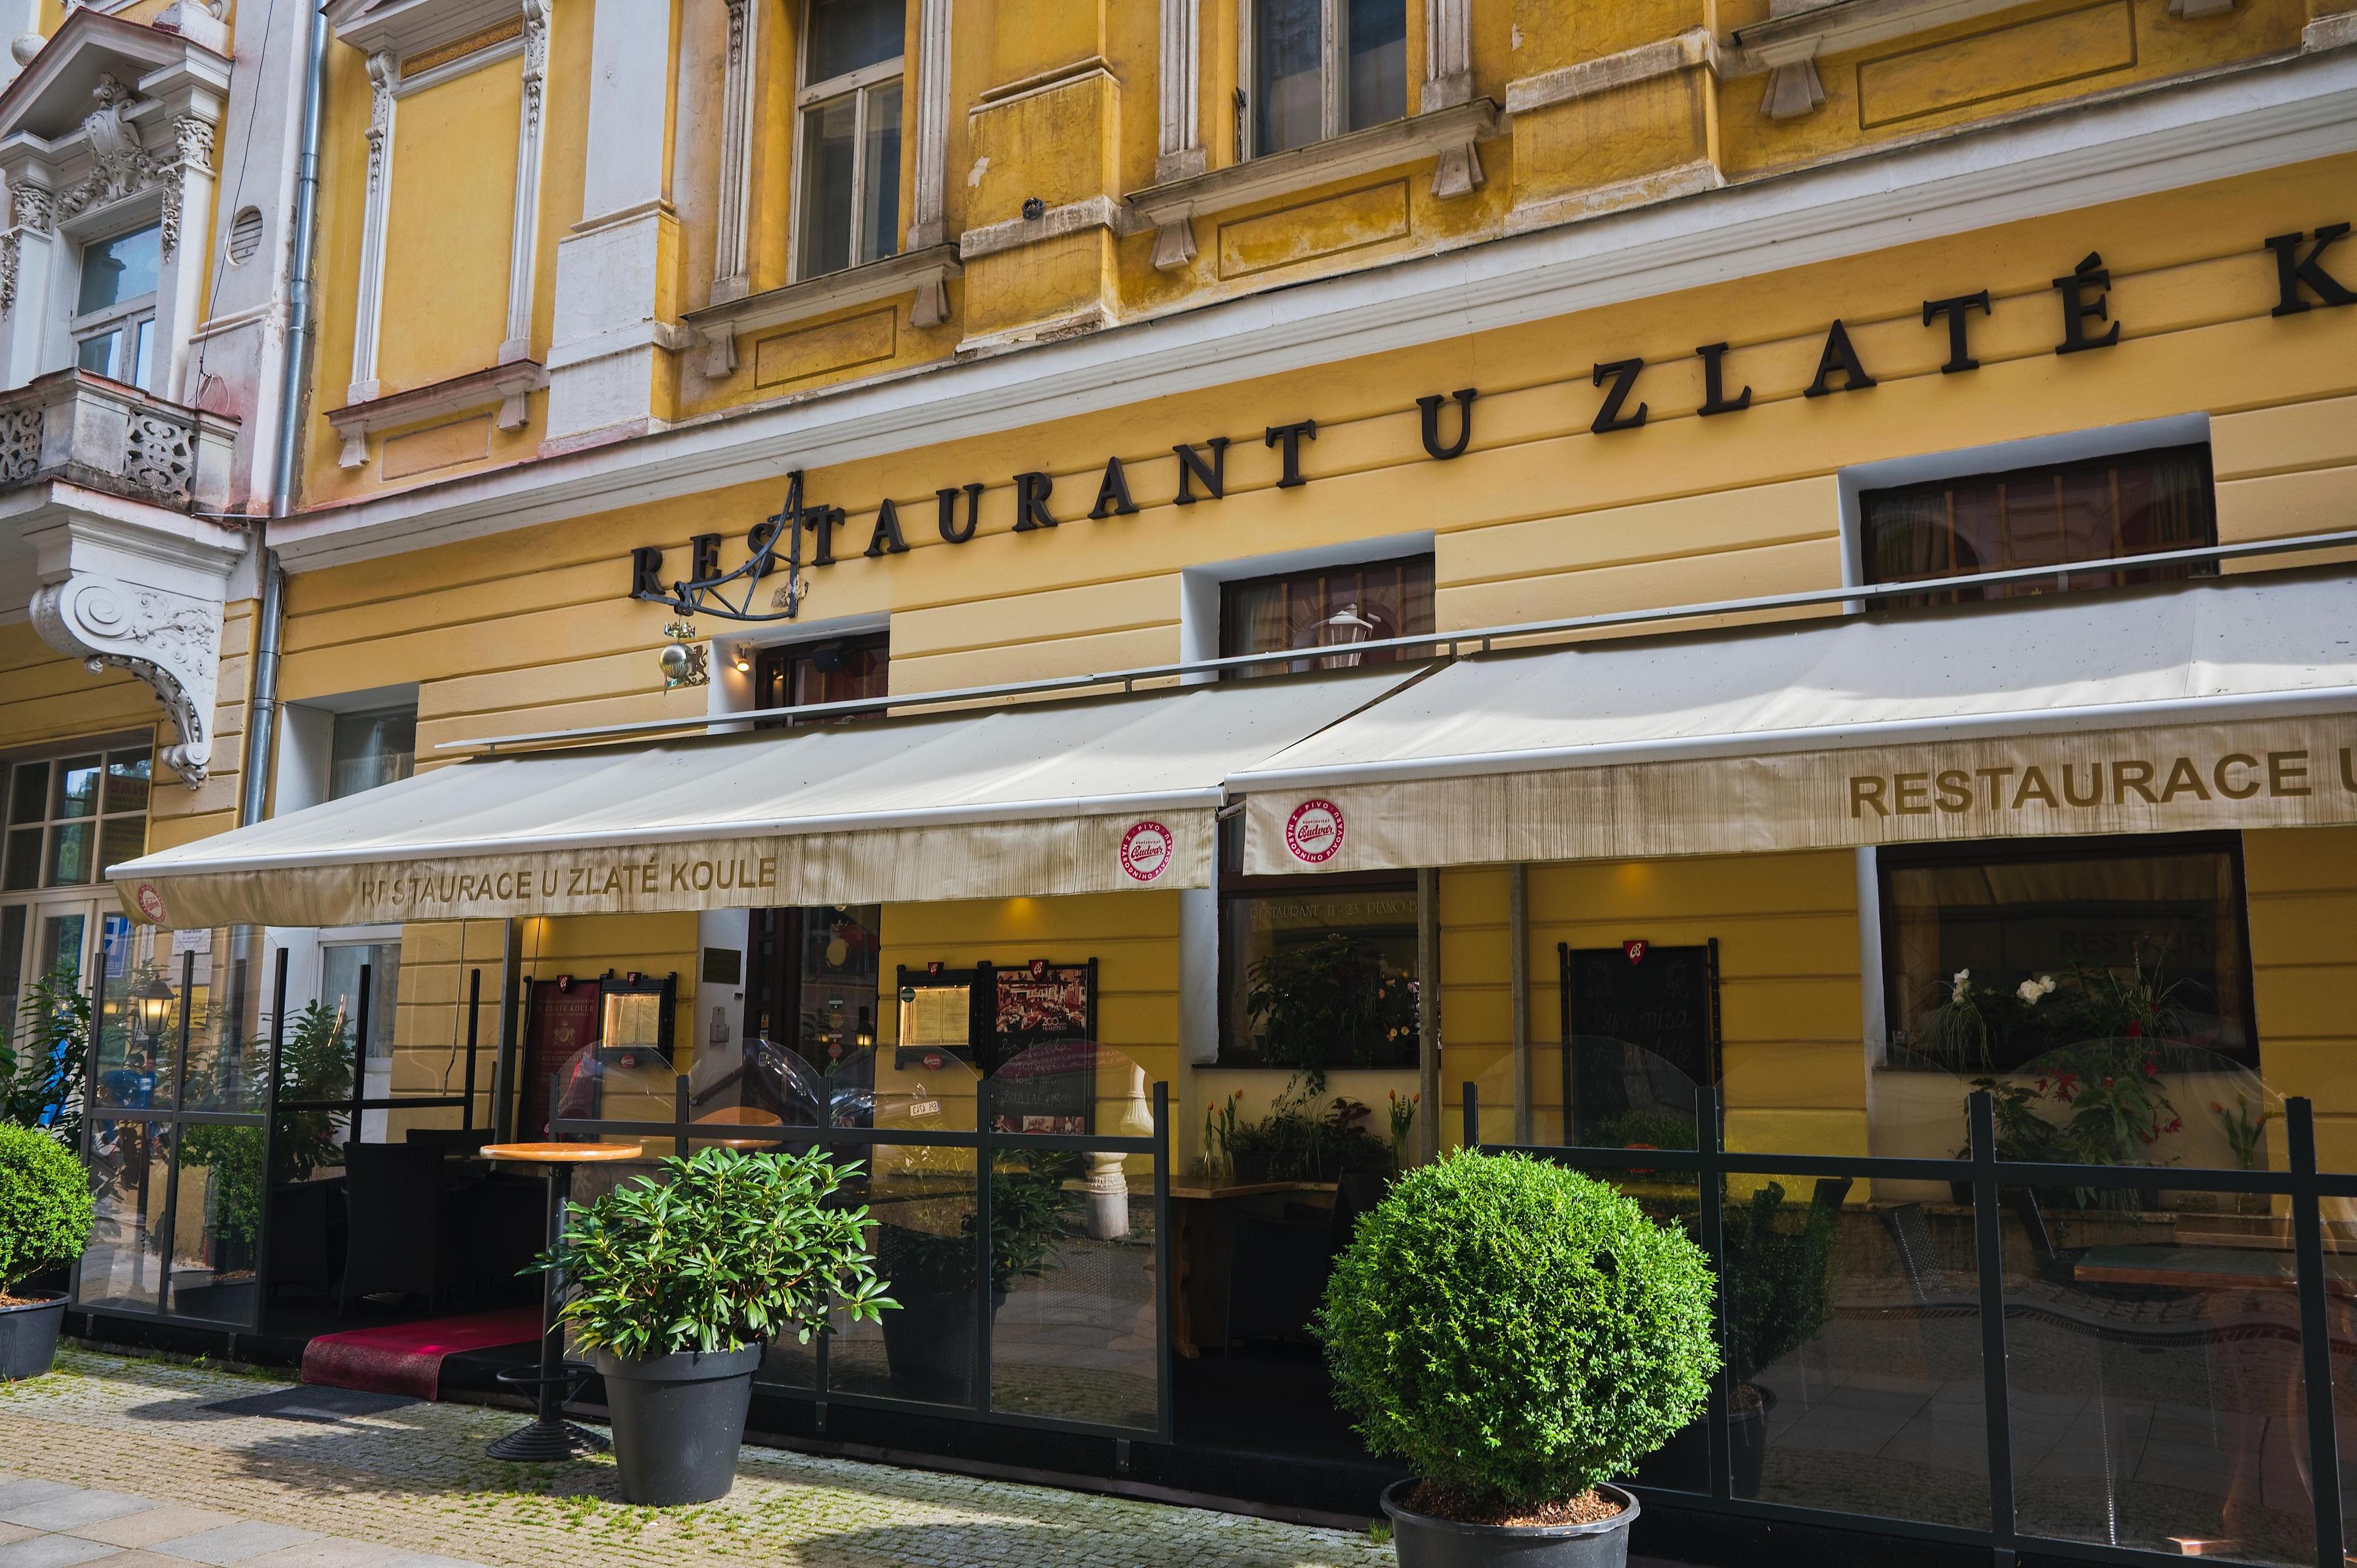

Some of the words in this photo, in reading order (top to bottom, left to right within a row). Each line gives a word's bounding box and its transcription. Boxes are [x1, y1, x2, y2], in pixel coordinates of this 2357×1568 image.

[628, 420, 1316, 599] RESTAURANT
[1415, 388, 1477, 461] U
[1591, 251, 2120, 435] ZLATÉ
[1850, 750, 2312, 818] RESTAURACE
[1305, 802, 1328, 810] PIVO
[1288, 824, 1323, 861] NÁRODNÍHO
[1326, 812, 1343, 856] PIVOVARU
[1297, 824, 1335, 841] Budvar
[1122, 844, 1153, 879] NÁRODNÍHO
[1155, 834, 1171, 875] PIVOVARU
[1131, 845, 1164, 861] Budvar
[361, 872, 532, 908] RESTAURACE
[542, 869, 558, 898] U
[567, 856, 659, 897] ZLATÉ
[671, 857, 777, 892] KOULE
[1249, 905, 1319, 920] RESTAURANT
[1347, 902, 1358, 916] 23
[1366, 900, 1405, 915] PIANO
[1042, 1017, 1059, 1026] 200
